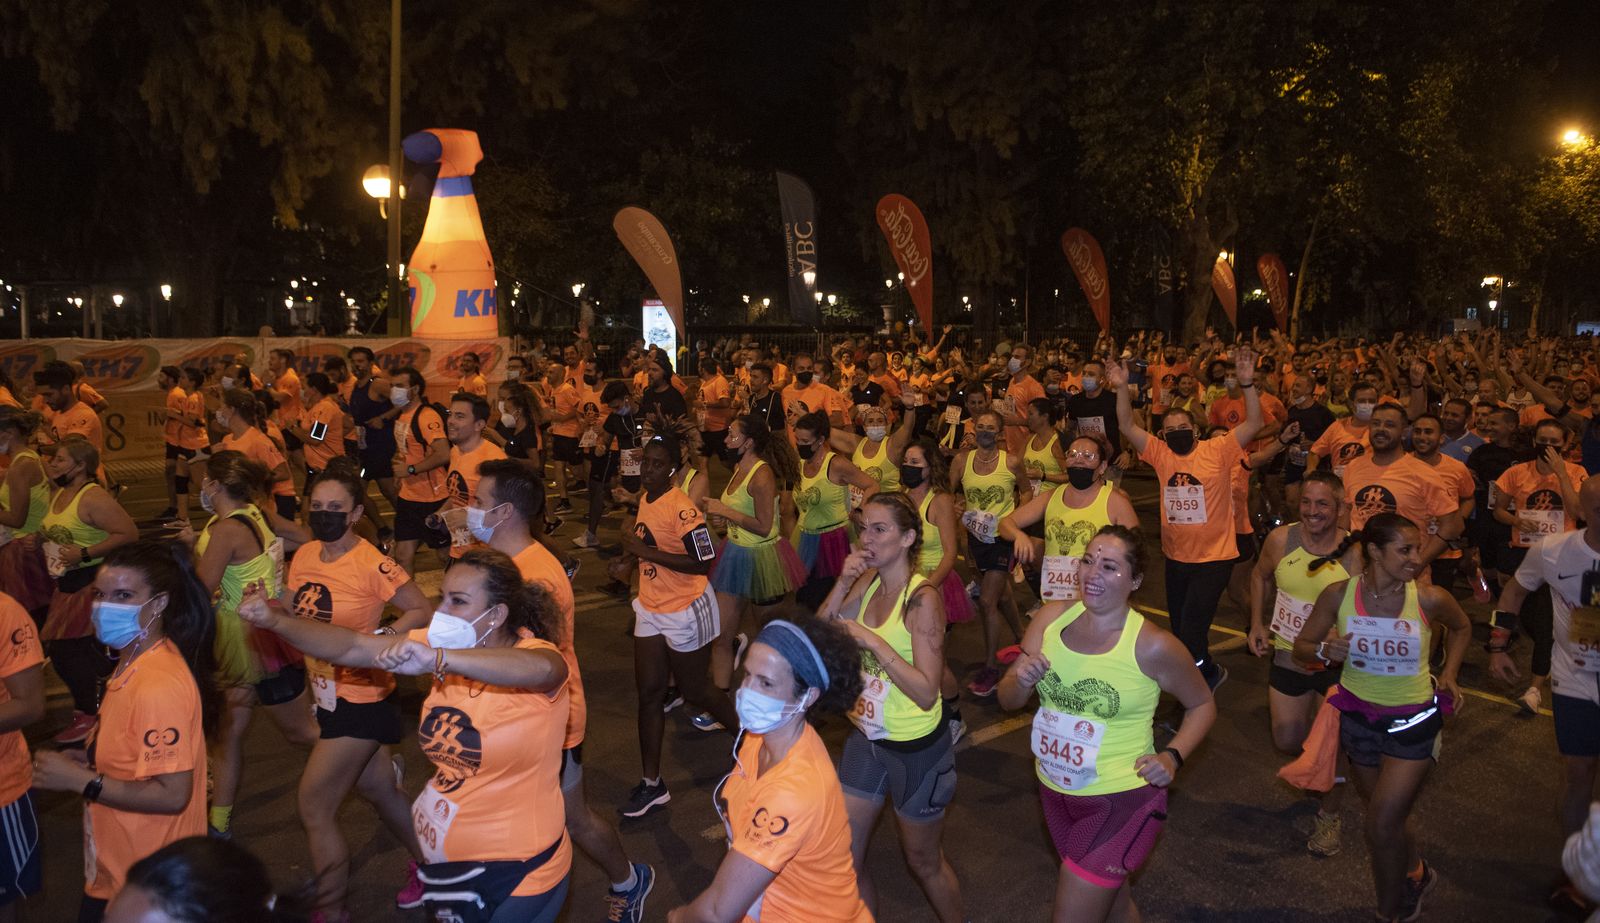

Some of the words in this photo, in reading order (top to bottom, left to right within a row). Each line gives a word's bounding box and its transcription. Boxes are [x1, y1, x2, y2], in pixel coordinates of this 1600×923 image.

[1169, 499, 1199, 511] 7959
[966, 518, 989, 534] 2678
[1047, 571, 1080, 586] 2449
[1279, 607, 1306, 629] 616
[1357, 637, 1410, 657] 6166
[1040, 734, 1085, 767] 5443
